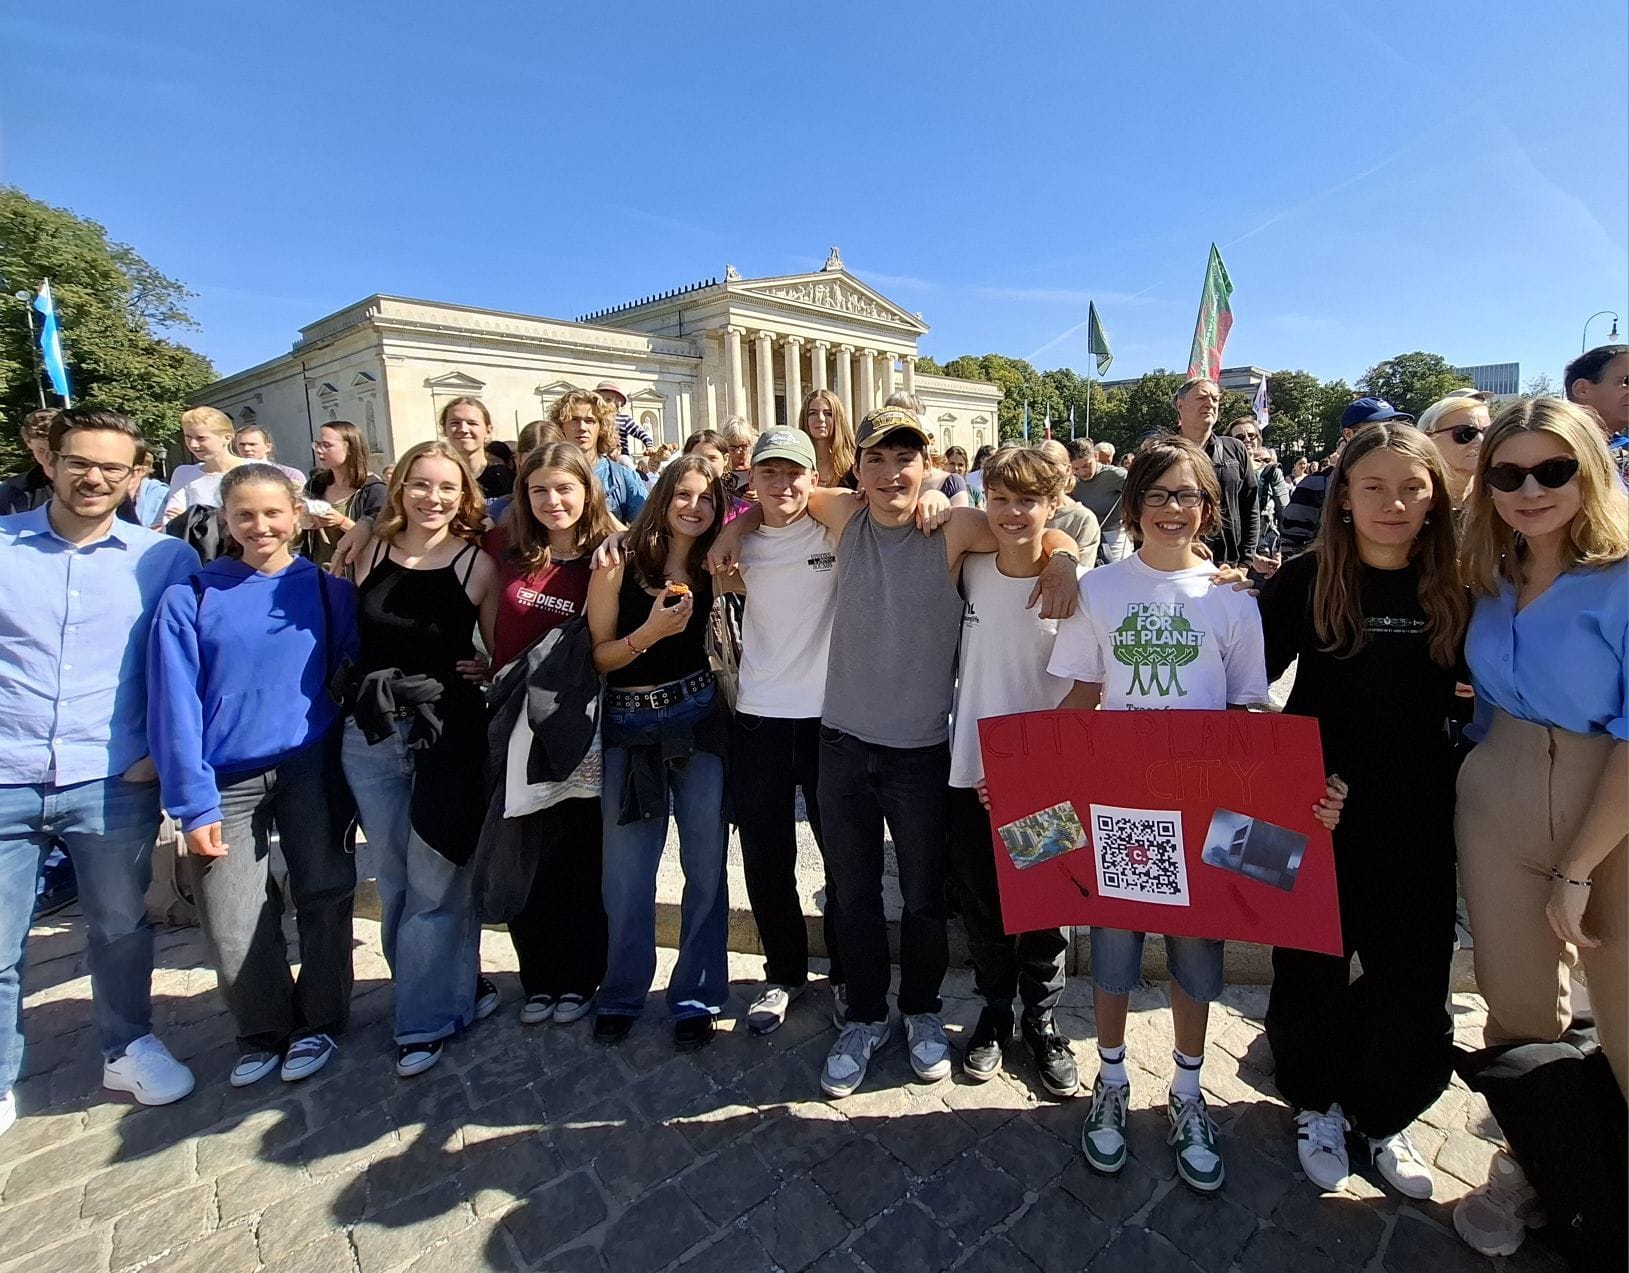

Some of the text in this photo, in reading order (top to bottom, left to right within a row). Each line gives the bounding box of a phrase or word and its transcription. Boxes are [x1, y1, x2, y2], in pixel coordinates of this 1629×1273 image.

[536, 593, 576, 613] DIESEL
[1127, 602, 1184, 617] PLANT
[1136, 615, 1173, 631] FOR
[1109, 630, 1205, 646] THE PLANET
[984, 711, 1289, 759] CITY PLANT
[1145, 759, 1265, 806] CITY
